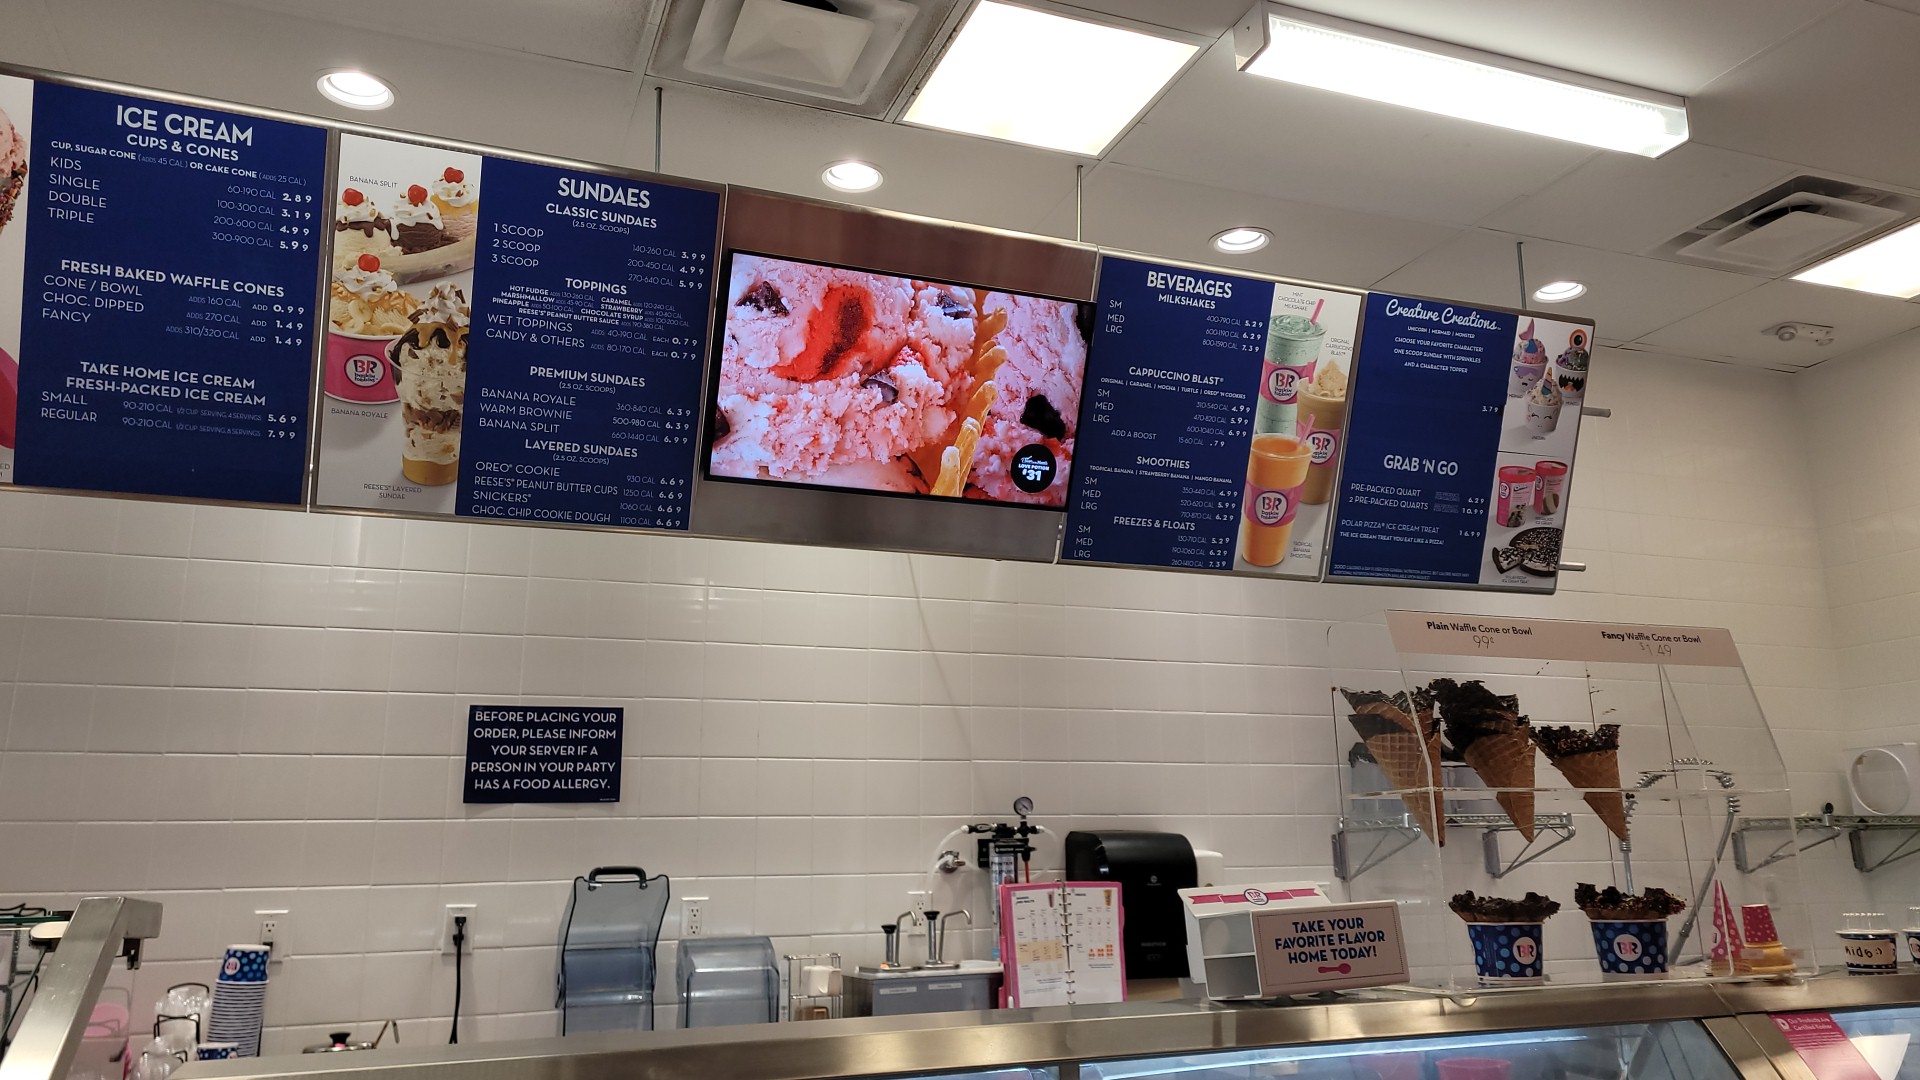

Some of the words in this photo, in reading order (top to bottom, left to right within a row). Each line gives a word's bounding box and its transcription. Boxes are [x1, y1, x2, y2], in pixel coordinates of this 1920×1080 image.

[117, 104, 158, 132] ICE
[164, 113, 253, 146] CREAM
[126, 134, 167, 150] CUPS
[171, 141, 182, 152] &
[186, 143, 239, 161] CONES
[51, 140, 73, 151] CUP,
[75, 144, 106, 156] SUGAR
[109, 149, 136, 160] CONE
[190, 161, 203, 169] OR
[205, 164, 229, 174] CAKE
[231, 167, 257, 178] CONE
[51, 156, 81, 171] KIDS
[49, 173, 100, 190] SINGLE
[350, 175, 378, 186] BANANA
[380, 180, 397, 188] SPLIT
[49, 190, 107, 208] DOUBLE
[558, 177, 650, 209] SUNDAES
[48, 207, 95, 224] TRIPLE
[546, 203, 598, 220] CLASSIC
[601, 211, 657, 229] SUNDAES
[494, 223, 498, 232] 1
[501, 224, 544, 238] SCOOP
[493, 239, 499, 247] 2
[502, 240, 541, 252] SCOOP
[492, 254, 497, 262] 3
[501, 256, 539, 267] SCOOP
[44, 275, 86, 290] CONE
[100, 281, 142, 296] BOWL
[61, 260, 111, 276] FRESH
[115, 267, 166, 283] BAKED
[170, 272, 229, 291] WAFFLE
[234, 281, 284, 297] CONES
[1147, 271, 1232, 299] BEVERAGES
[526, 287, 548, 295] FUDGE
[565, 278, 627, 295] TOPPINGS
[43, 292, 91, 307] CHOC.
[95, 297, 144, 312] DIPPED
[492, 298, 529, 307] PINEAPPLE
[501, 291, 555, 302] MARSHMALLOW
[601, 297, 631, 306] CARAMEL
[1109, 299, 1122, 309] SM
[1158, 293, 1216, 310] MILKSHAKES
[42, 308, 91, 323] FANCY
[601, 304, 643, 314] STRAWBERRY
[1386, 298, 1439, 322] Creature
[487, 314, 512, 325] WET
[516, 317, 573, 332] TOPPINGS
[1107, 313, 1125, 323] MED
[1106, 325, 1122, 334] LRG
[486, 329, 526, 342] CANDY
[530, 334, 537, 343] &
[541, 335, 585, 348] OTHERS
[80, 361, 119, 376] TAKE
[123, 365, 170, 381] HOME
[174, 370, 199, 384] ICE
[203, 374, 255, 390] CREAM
[1129, 366, 1190, 382] CAPPUCCINO
[1421, 363, 1449, 371] CHARACTER
[1450, 366, 1468, 374] TOPPER
[530, 366, 587, 381] PREMIUM
[590, 372, 645, 387] SUNDAES
[42, 391, 88, 405] SMALL
[66, 377, 181, 398] FRESH-PACKED
[185, 386, 209, 400] ICE
[213, 390, 266, 406] CREAM
[481, 388, 530, 401] BANANA
[533, 393, 576, 406] ROYALE
[1097, 389, 1110, 397] SM
[331, 408, 359, 416] BANANA
[362, 411, 388, 419] ROYALE
[480, 403, 516, 415] WARM
[519, 406, 572, 420] BROWNIE
[1095, 402, 1114, 411] MED
[41, 408, 97, 423] REGULAR
[1093, 414, 1109, 423] LRG
[479, 418, 527, 430] BANANA
[530, 423, 560, 433] SPLIT
[525, 439, 580, 452] LAYERED
[583, 445, 637, 458] SUNDAES
[515, 464, 560, 476] COOKIE
[1136, 456, 1190, 470] SMOOTHIES
[1384, 454, 1419, 473] GRAB
[1437, 461, 1458, 476] GO
[516, 480, 554, 490] PEANUT
[557, 483, 591, 493] BUTTER
[594, 485, 618, 495] CUPS
[1085, 477, 1097, 485] SM
[1083, 489, 1101, 498] MED
[1351, 483, 1395, 496] PRE-PACKED
[1397, 487, 1421, 497] QUART
[1081, 502, 1098, 511] LRG
[1355, 497, 1398, 508] PRE-PACKED
[1400, 500, 1429, 511] QUARTS
[472, 505, 505, 515] CHOC.
[508, 507, 531, 517] CHIP
[534, 509, 572, 521] COOKIE
[575, 512, 610, 523] DOUGH
[1078, 525, 1091, 533] SM
[1113, 516, 1152, 527] FREEZES
[1155, 520, 1161, 528] &
[1162, 521, 1195, 531] FLOATS
[1342, 519, 1363, 529] POLAR
[1386, 523, 1395, 531] ICE
[1397, 524, 1420, 532] CREAM
[1421, 525, 1440, 534] TREAT
[1076, 537, 1093, 546] MED
[1074, 550, 1091, 558] LRG
[1427, 621, 1449, 631] Plain
[1450, 623, 1477, 632] Waffle
[1479, 625, 1500, 634] Cone
[1512, 627, 1532, 636] Bowl
[1601, 631, 1625, 642] Fancy
[1626, 632, 1651, 642] Waffle
[1652, 634, 1671, 643] Cone
[1682, 635, 1701, 643] Bowl
[475, 711, 524, 722] BEFORE
[526, 712, 580, 722] PLACING
[582, 713, 617, 723] YOUR
[473, 728, 519, 739] ORDER,
[522, 729, 567, 739] PLEASE
[569, 729, 616, 739] INFORM
[491, 745, 526, 755] YOUR
[529, 745, 575, 755] SERVER
[577, 746, 587, 755] IF
[590, 746, 598, 755] A
[471, 762, 521, 772] PERSON
[524, 762, 536, 772] IN
[539, 762, 573, 772] YOUR
[577, 762, 616, 772] PARTY
[474, 779, 500, 789] HAS
[502, 779, 511, 789] A
[513, 779, 550, 789] FOOD
[553, 779, 610, 789] ALLERGY.
[1292, 920, 1326, 933] TAKE
[1328, 917, 1364, 931] YOUR
[1275, 933, 1335, 950] FAVORITE
[1338, 931, 1385, 945] FLAVOR
[1288, 948, 1328, 964] HOME
[1330, 946, 1377, 960] TODAY!
[1517, 944, 1534, 958] BR
[1617, 942, 1638, 955] BR
